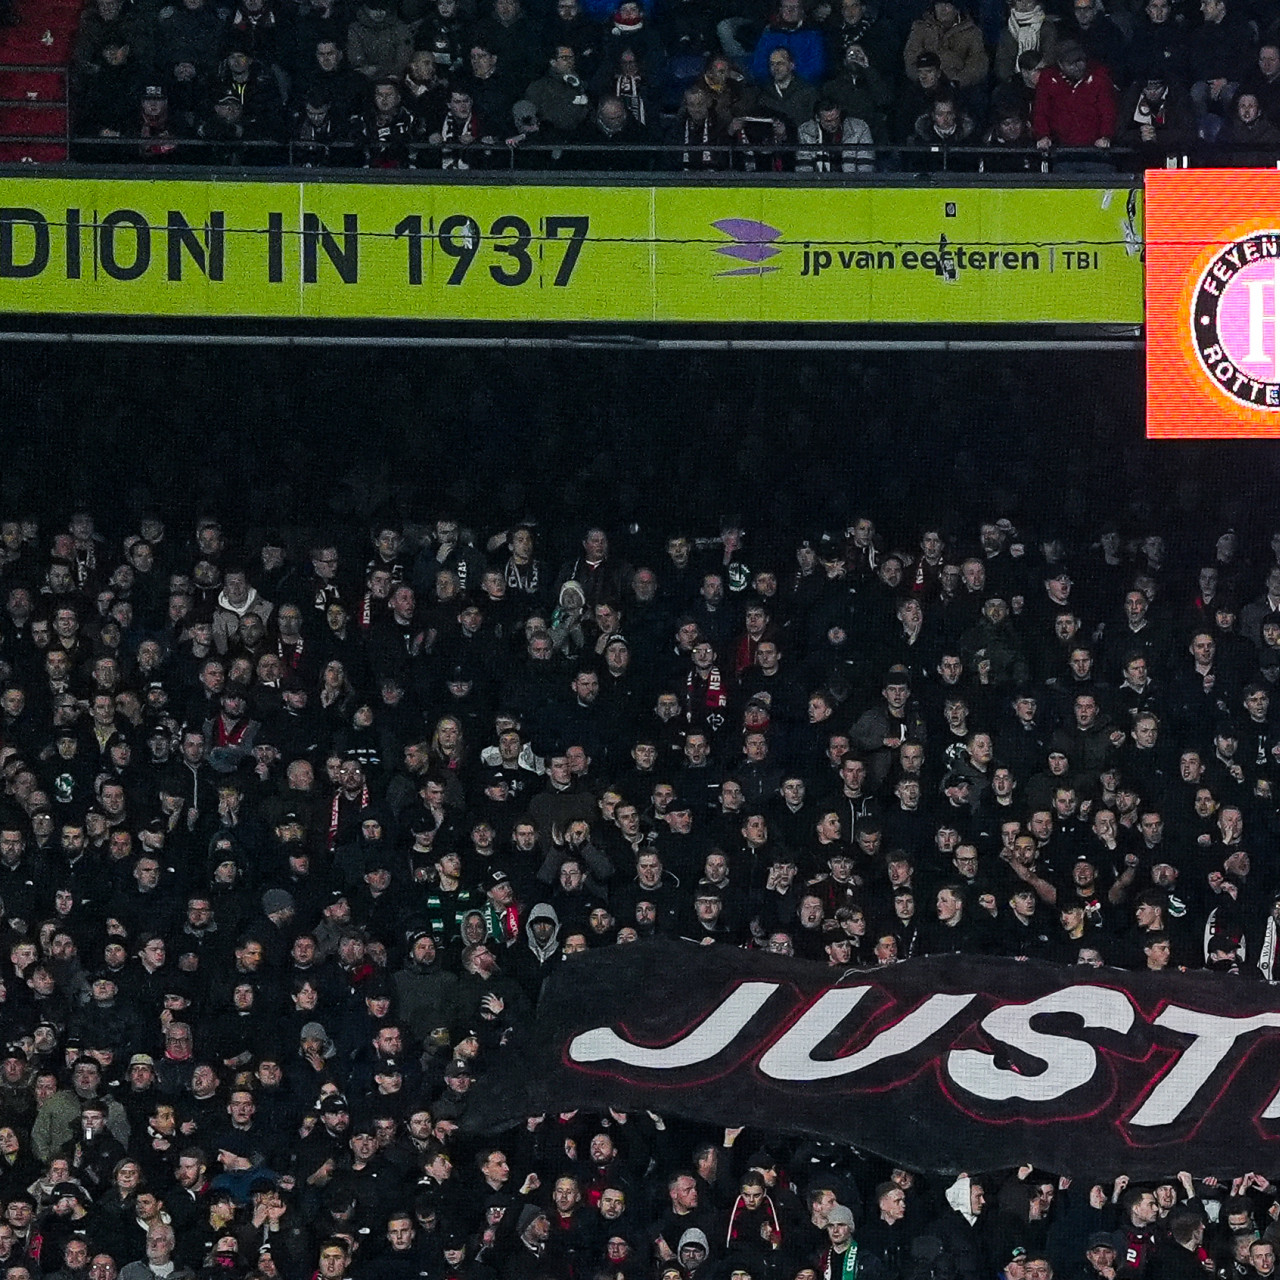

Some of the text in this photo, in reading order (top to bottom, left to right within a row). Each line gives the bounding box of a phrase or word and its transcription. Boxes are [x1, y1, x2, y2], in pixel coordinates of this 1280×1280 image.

[269, 212, 359, 284] IN
[395, 215, 590, 287] 1937
[801, 243, 832, 275] jp
[840, 250, 893, 271] van
[1064, 253, 1098, 270] TBI
[847, 1246, 857, 1272] CELTIC
